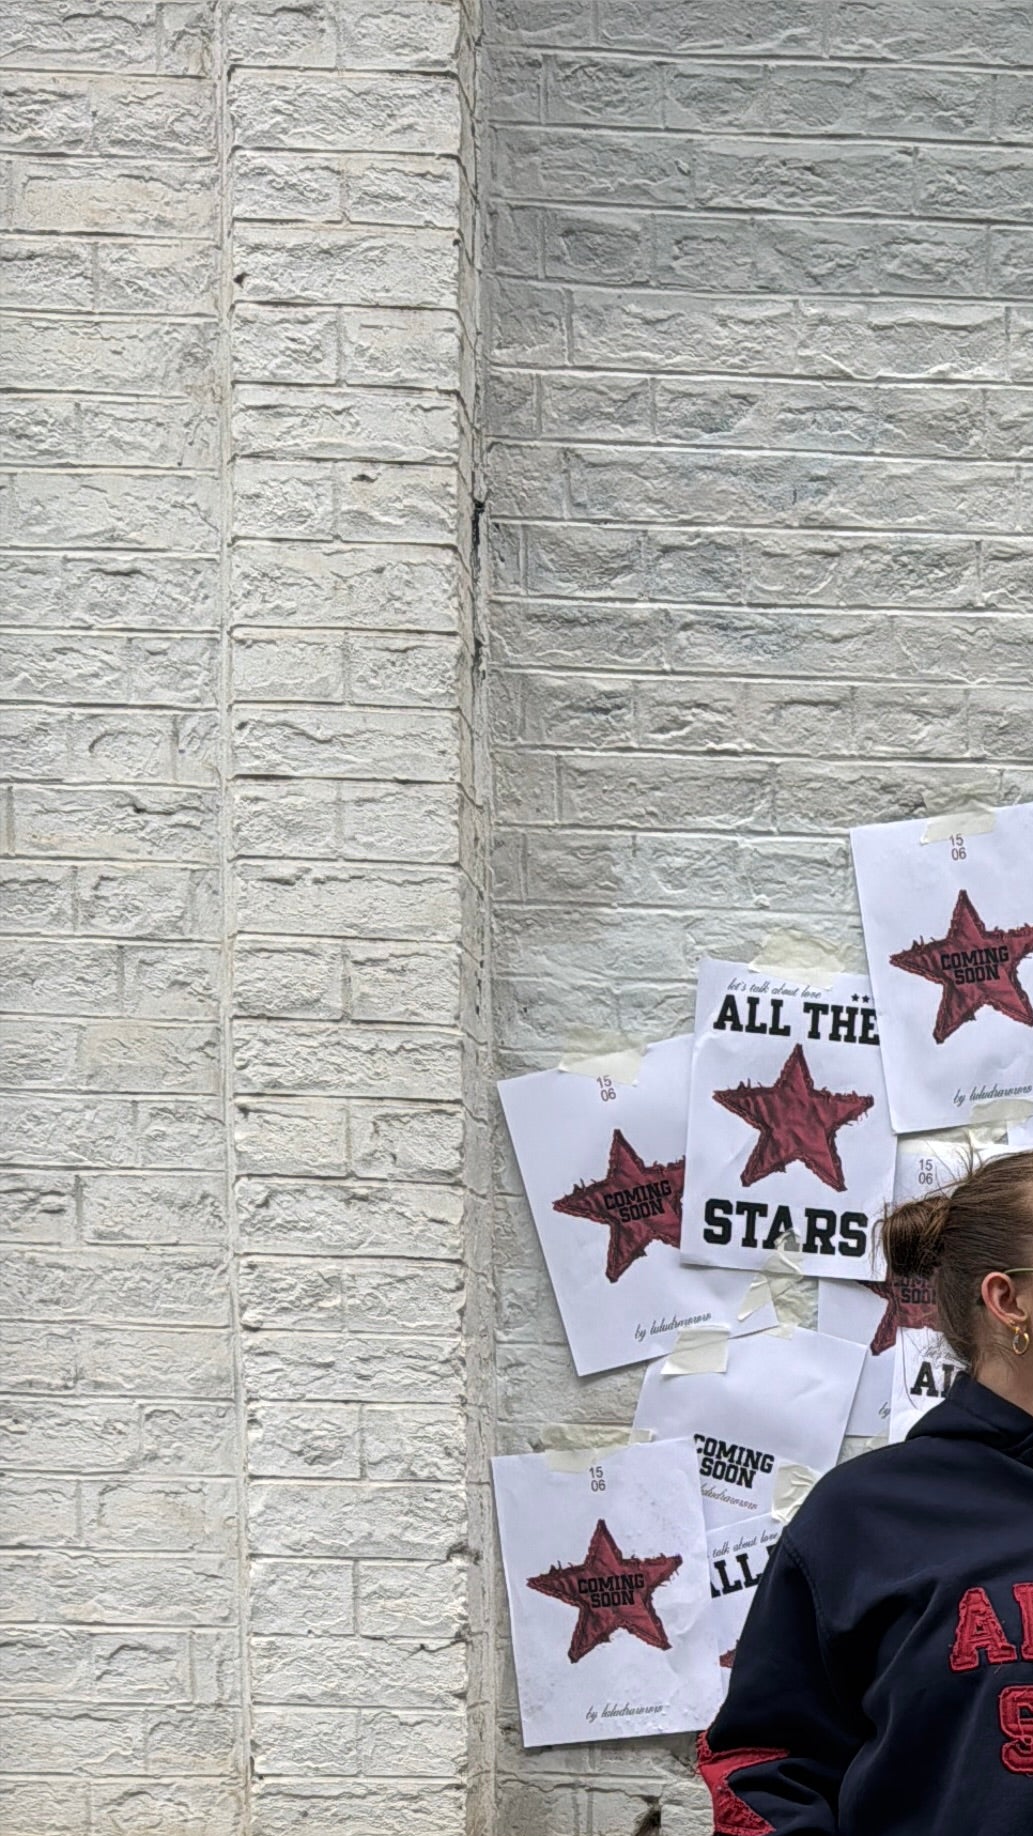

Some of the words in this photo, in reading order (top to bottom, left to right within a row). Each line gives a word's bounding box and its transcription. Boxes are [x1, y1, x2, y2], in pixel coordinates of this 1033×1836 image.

[949, 833, 964, 847] 15
[951, 848, 967, 861] 06
[940, 945, 1010, 970] COMING
[953, 965, 1000, 985] SOON
[727, 977, 746, 992] let's
[750, 980, 770, 994] talk
[771, 982, 799, 997] about
[801, 984, 822, 999] love
[713, 994, 791, 1036] ALL
[803, 1001, 880, 1046] THE
[596, 1075, 612, 1088] 15
[600, 1088, 617, 1102] 06
[953, 1088, 966, 1108] by
[919, 1158, 933, 1171] 15
[918, 1172, 933, 1185] 06
[603, 1180, 672, 1210] COMING
[619, 1198, 665, 1223] SOON
[703, 1198, 868, 1257] STARS
[634, 1323, 647, 1343] by
[693, 1433, 774, 1474] COMING
[589, 1467, 603, 1479] 15
[699, 1457, 757, 1489] SOON
[590, 1479, 606, 1492] 06
[712, 1540, 730, 1559] talk
[733, 1536, 757, 1551] about
[760, 1529, 777, 1544] love
[578, 1573, 644, 1595] COMING
[590, 1590, 635, 1608] SOON
[585, 1706, 598, 1723] by
